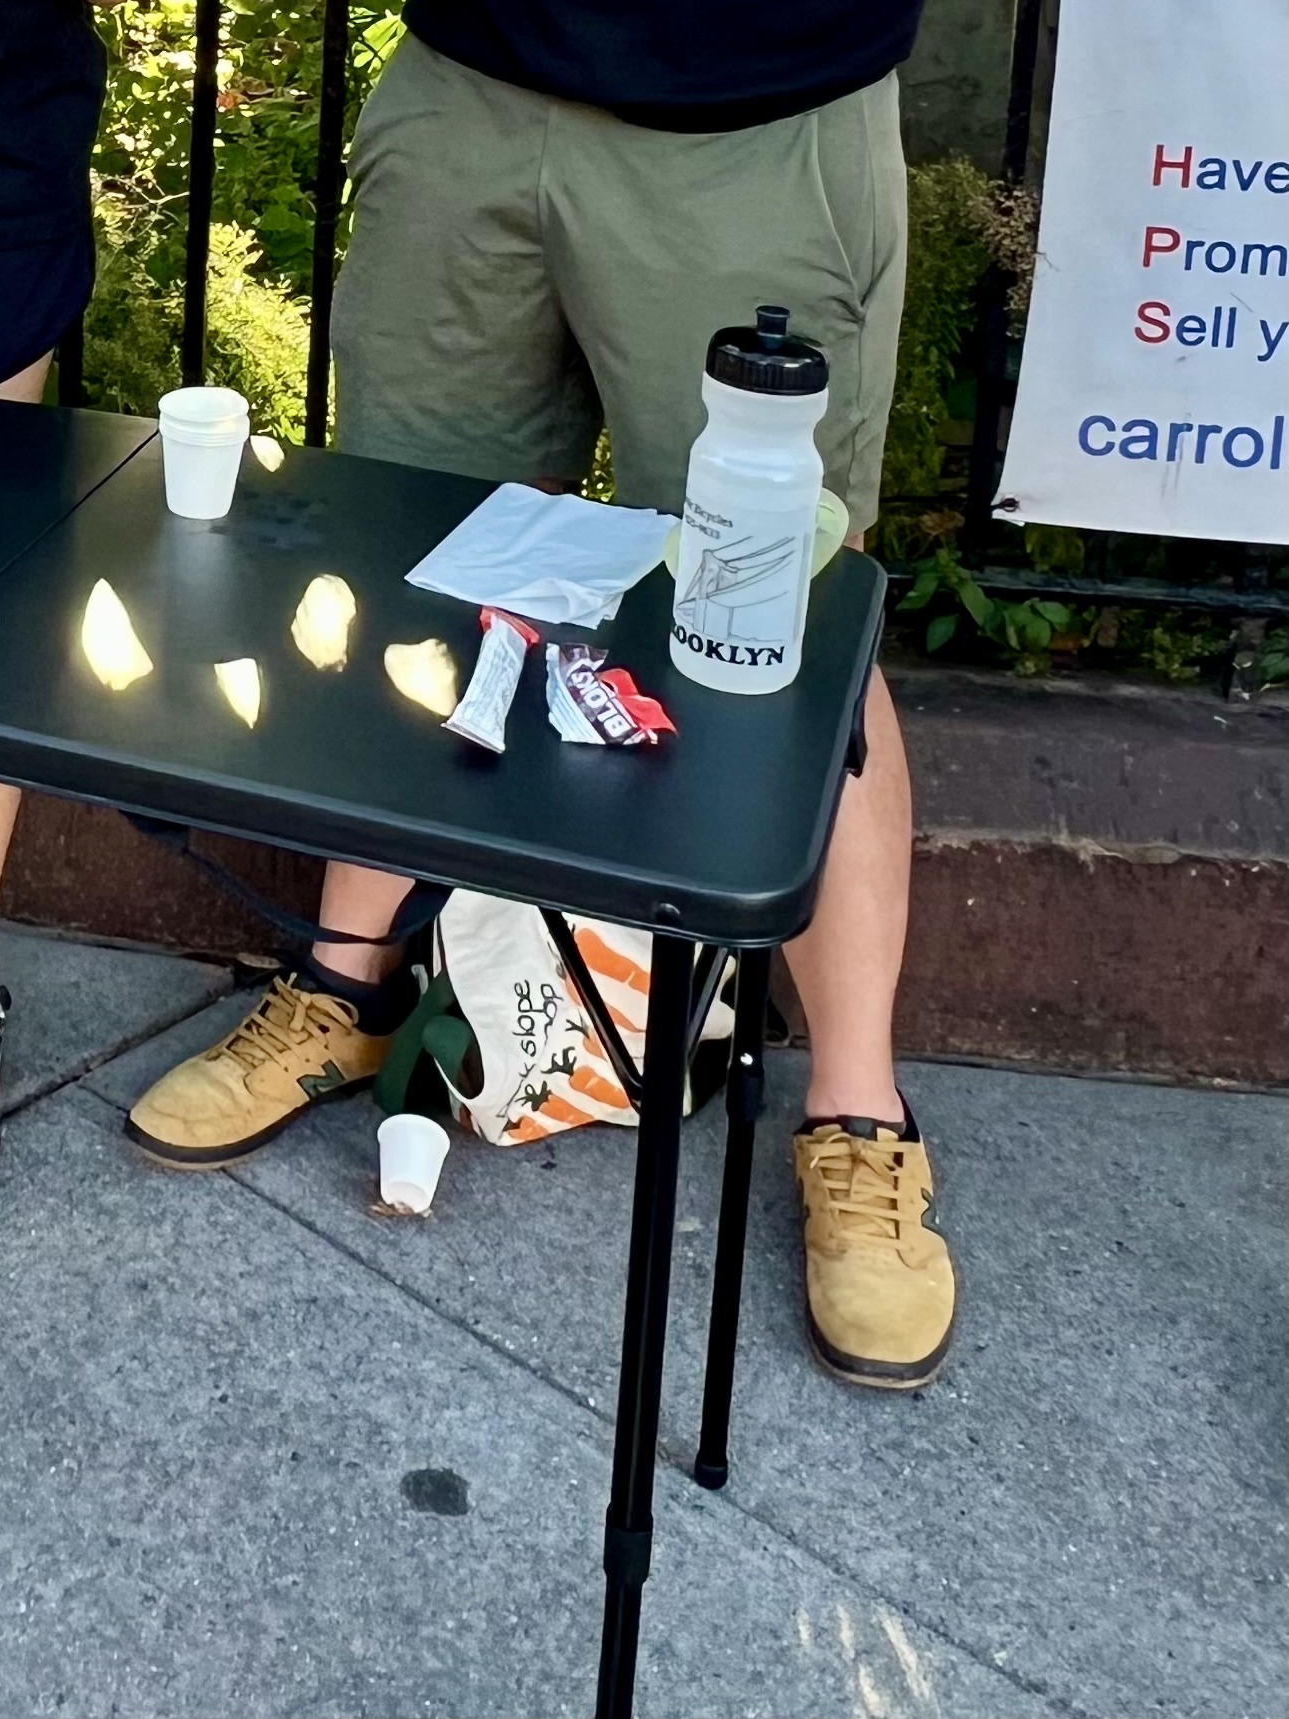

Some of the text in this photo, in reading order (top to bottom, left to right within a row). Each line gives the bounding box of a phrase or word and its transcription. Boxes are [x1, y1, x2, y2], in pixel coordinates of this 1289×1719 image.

[1152, 144, 1289, 194] Have
[1142, 226, 1288, 277] Prom
[1134, 301, 1237, 349] Sell
[1078, 414, 1285, 470] carrol
[671, 624, 785, 667] OOKLYN
[570, 671, 632, 738] BLOKS
[512, 979, 544, 1057] slope
